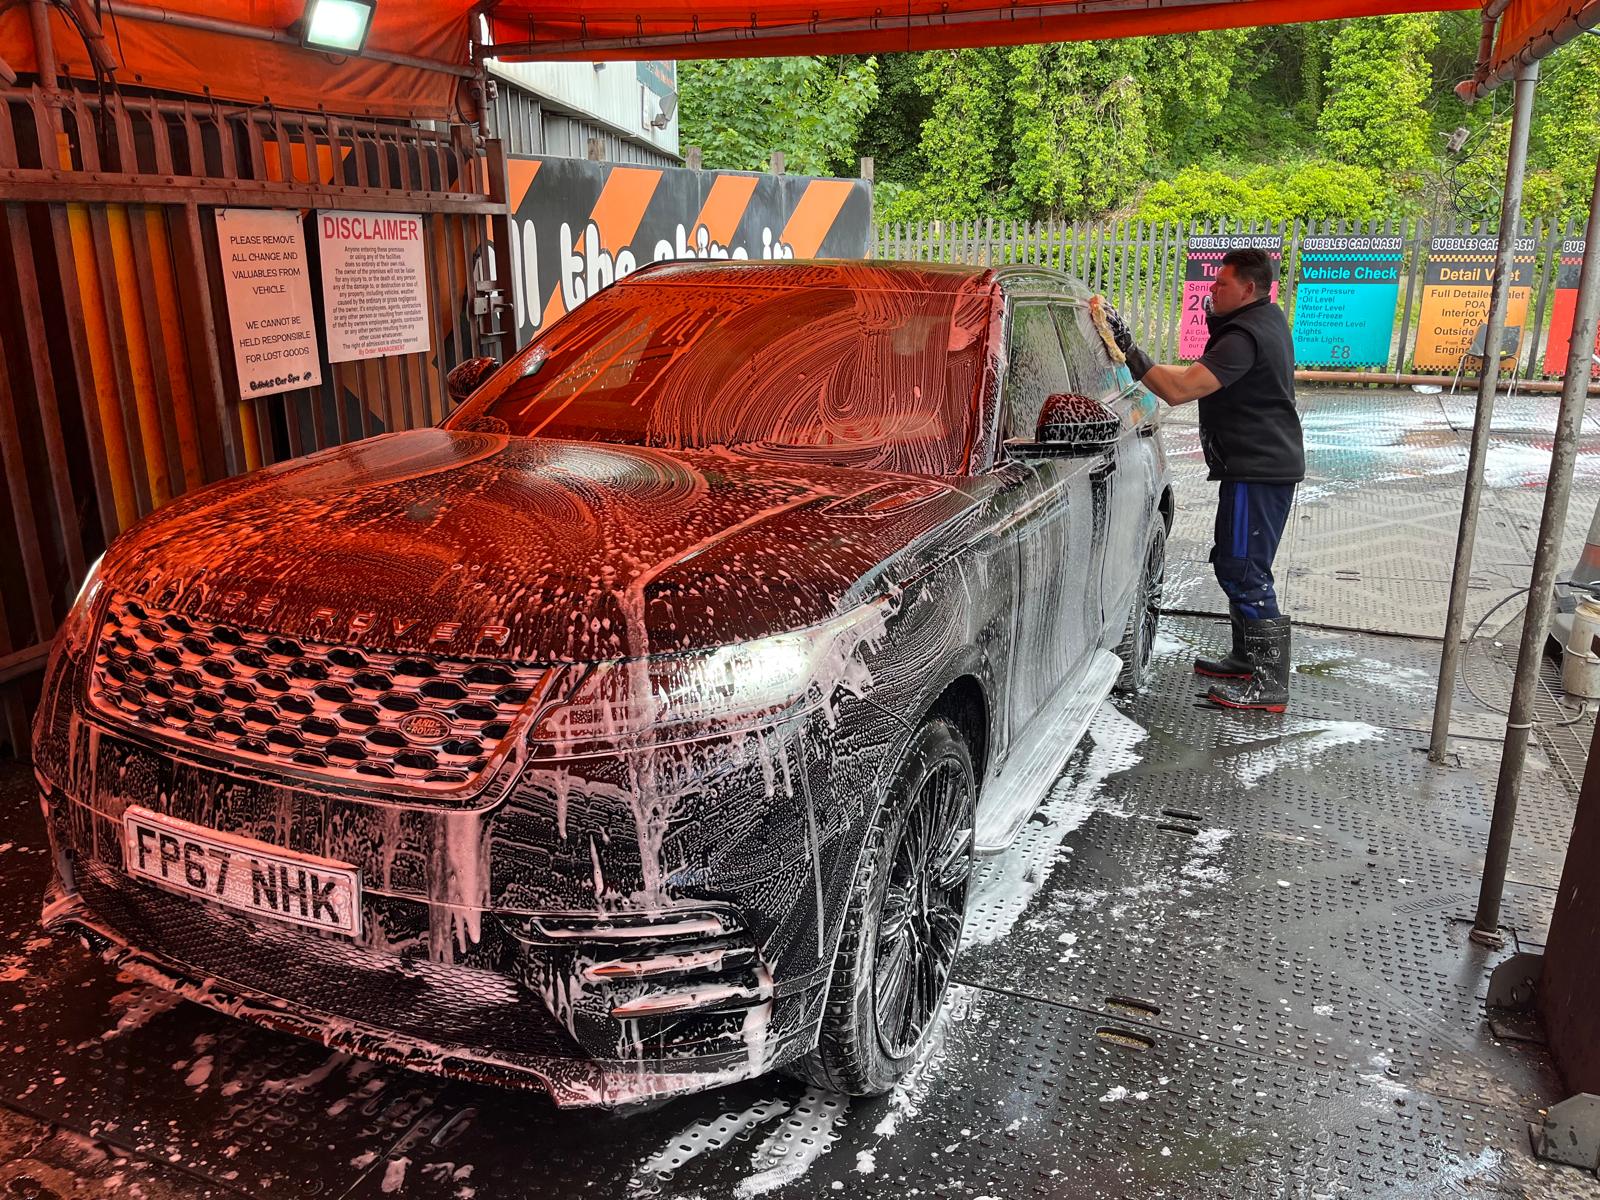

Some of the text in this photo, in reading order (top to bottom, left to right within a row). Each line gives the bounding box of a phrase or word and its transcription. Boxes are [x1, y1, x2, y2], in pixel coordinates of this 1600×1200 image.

[323, 216, 418, 240] DISCLAIMER
[230, 235, 295, 244] PLEASE REMOVE
[1189, 236, 1281, 249] BUBBLES CAR WASH
[1304, 237, 1402, 250] BUBBLES CAR WASH
[1431, 238, 1478, 251] BUBBLES
[1514, 239, 1535, 251] ASH
[232, 252, 298, 262] ALL CHANGE AND
[560, 222, 636, 312] the
[232, 268, 300, 279] VALUABLES FROM
[1302, 267, 1398, 279] Vehicle Check
[1440, 268, 1520, 281] Detail Vet
[1188, 283, 1210, 291] Seni
[1304, 288, 1319, 296] Tyre
[1431, 289, 1450, 298] Full
[1465, 301, 1486, 309] POA
[1442, 309, 1480, 317] Interior
[246, 316, 301, 330] WE CANNOT BE
[1345, 320, 1366, 328] Level
[1298, 328, 1321, 336] Lights
[1434, 327, 1474, 336] Outside
[240, 331, 311, 347] HELD RESPONSIBLE
[1321, 336, 1344, 344] Lights
[246, 347, 309, 363] FOR LOST GOODS
[1331, 345, 1351, 359] £8
[288, 373, 300, 384] Spa
[411, 717, 436, 727] LAND
[412, 726, 441, 737] ROVER
[136, 825, 340, 924] FP67 NHK
